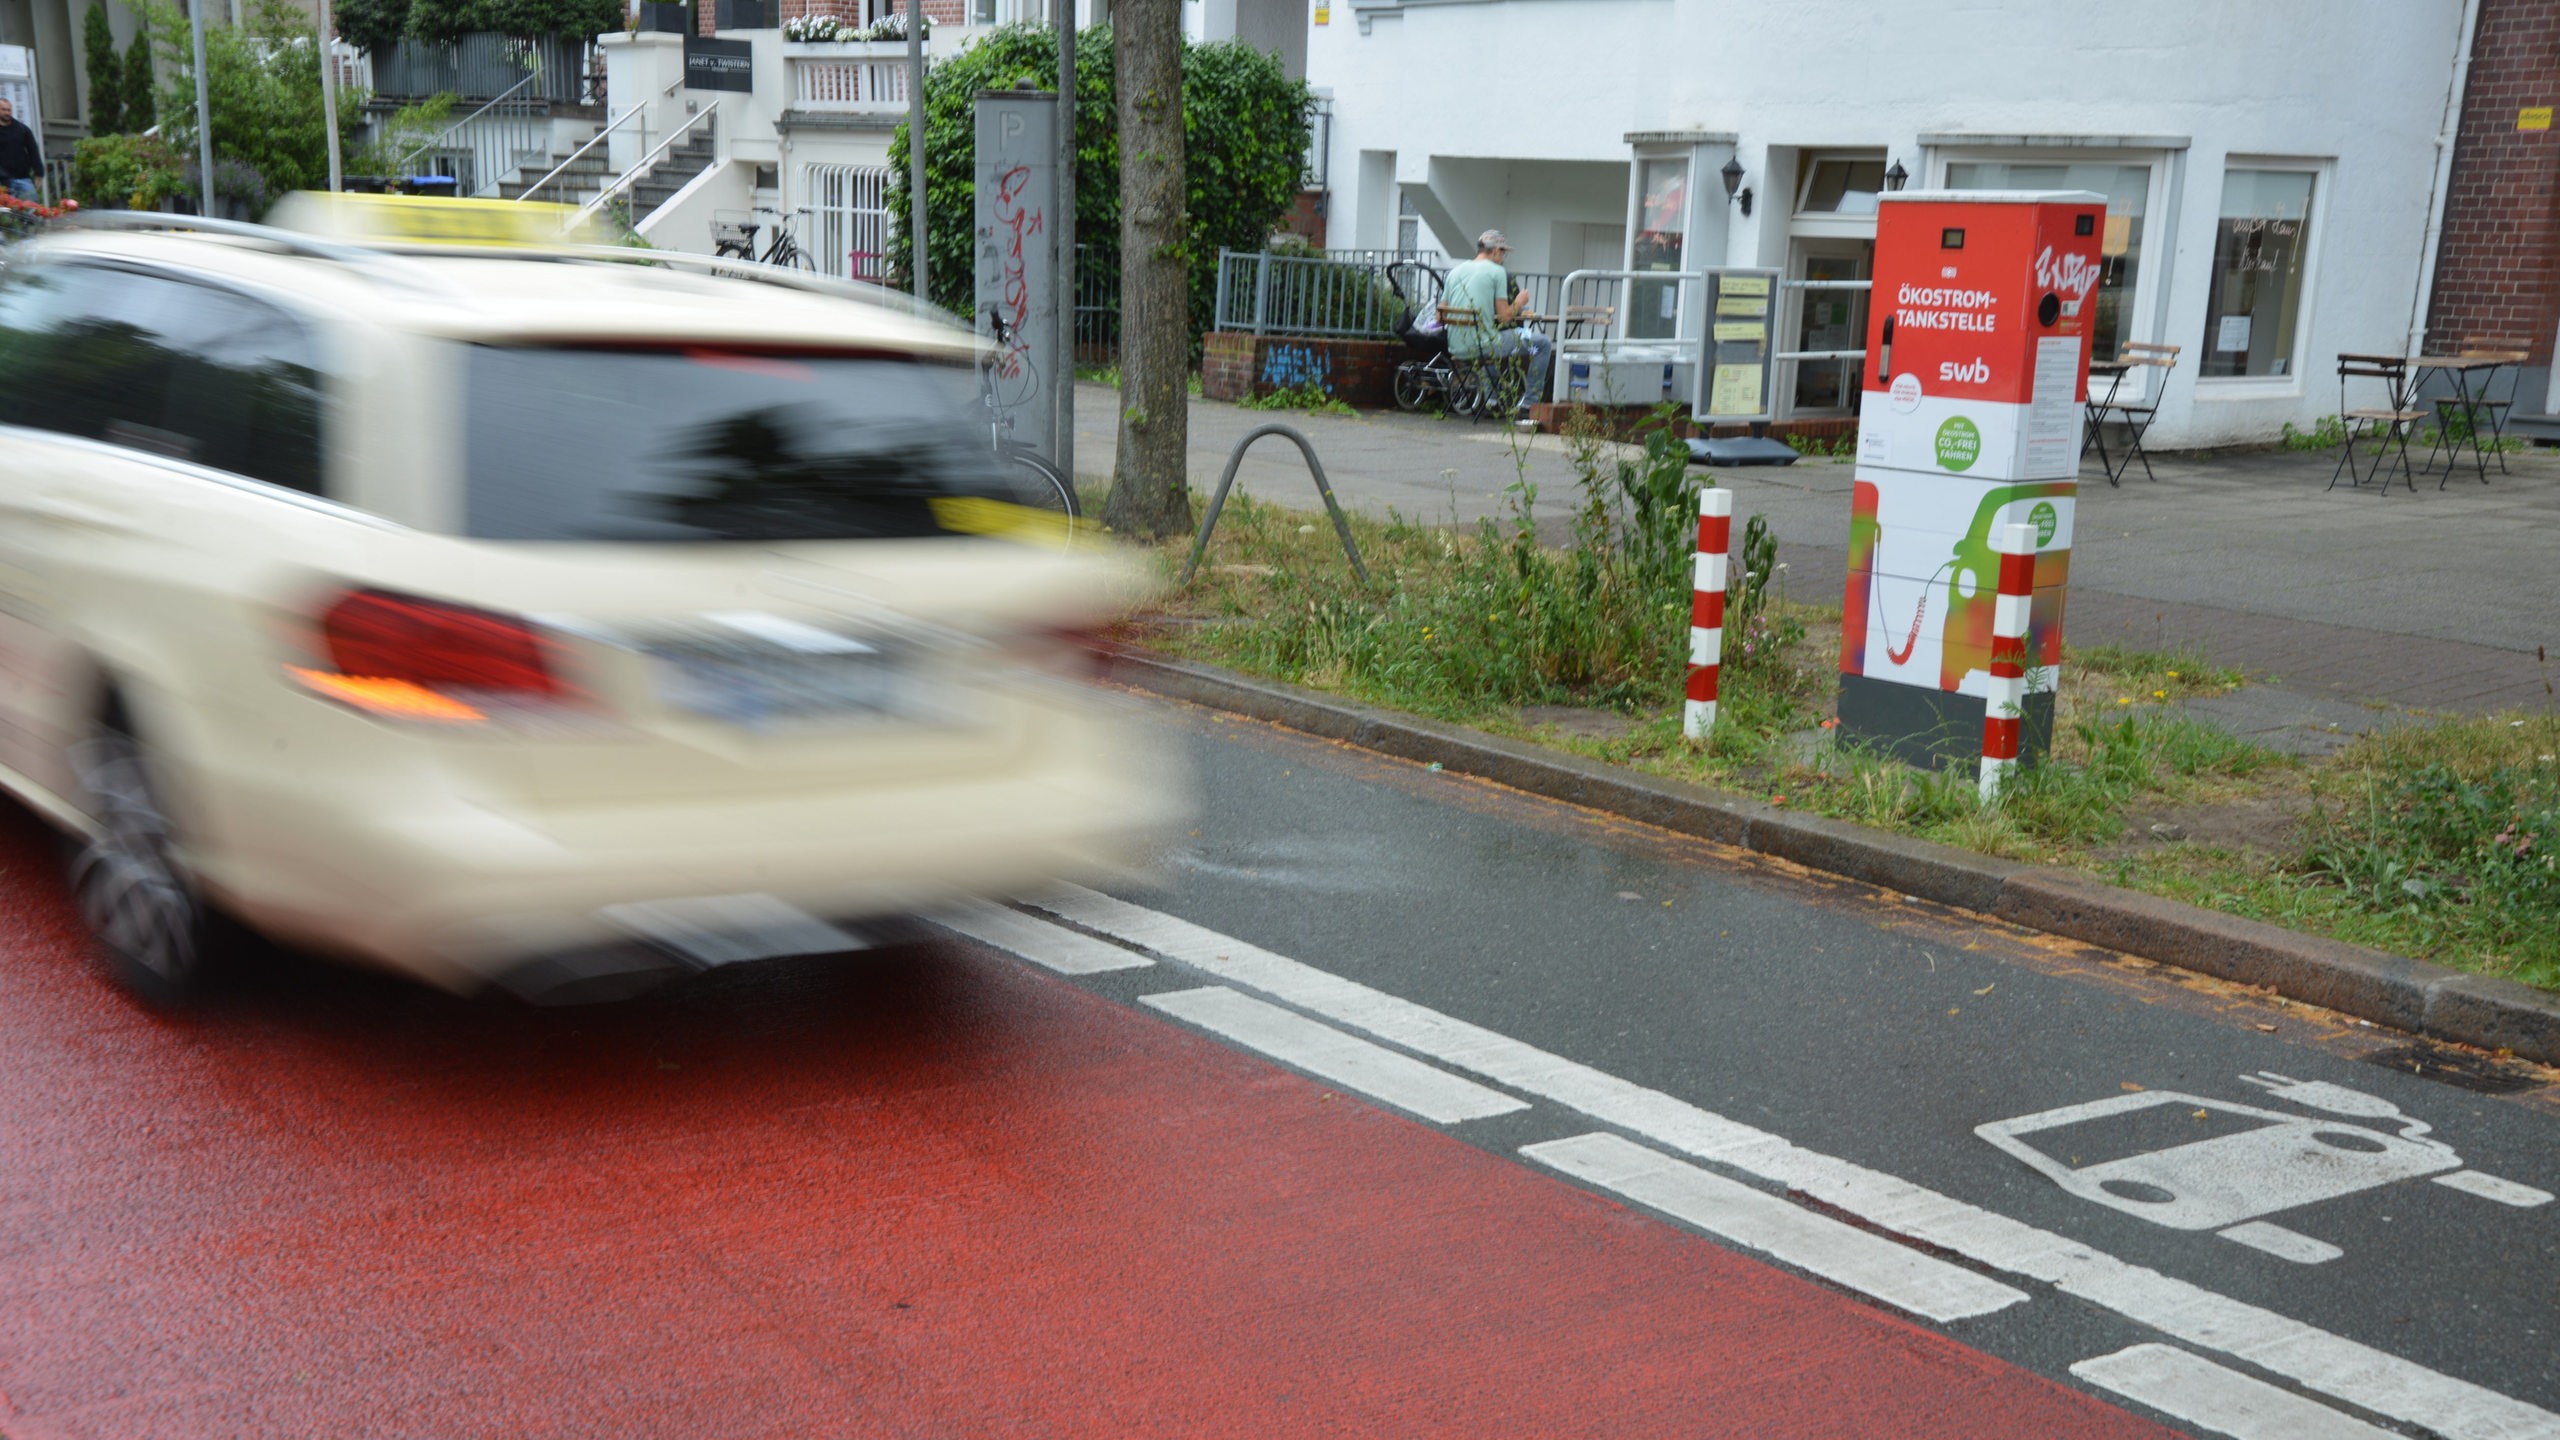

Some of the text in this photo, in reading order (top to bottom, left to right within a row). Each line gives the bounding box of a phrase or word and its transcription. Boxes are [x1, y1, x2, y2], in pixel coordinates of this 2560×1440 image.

[1898, 283, 1997, 309] ÖKOSTROM-
[1896, 309, 1996, 333] TANKSTELLE
[1939, 356, 1990, 384] swb
[1940, 449, 1973, 461] FAHREN
